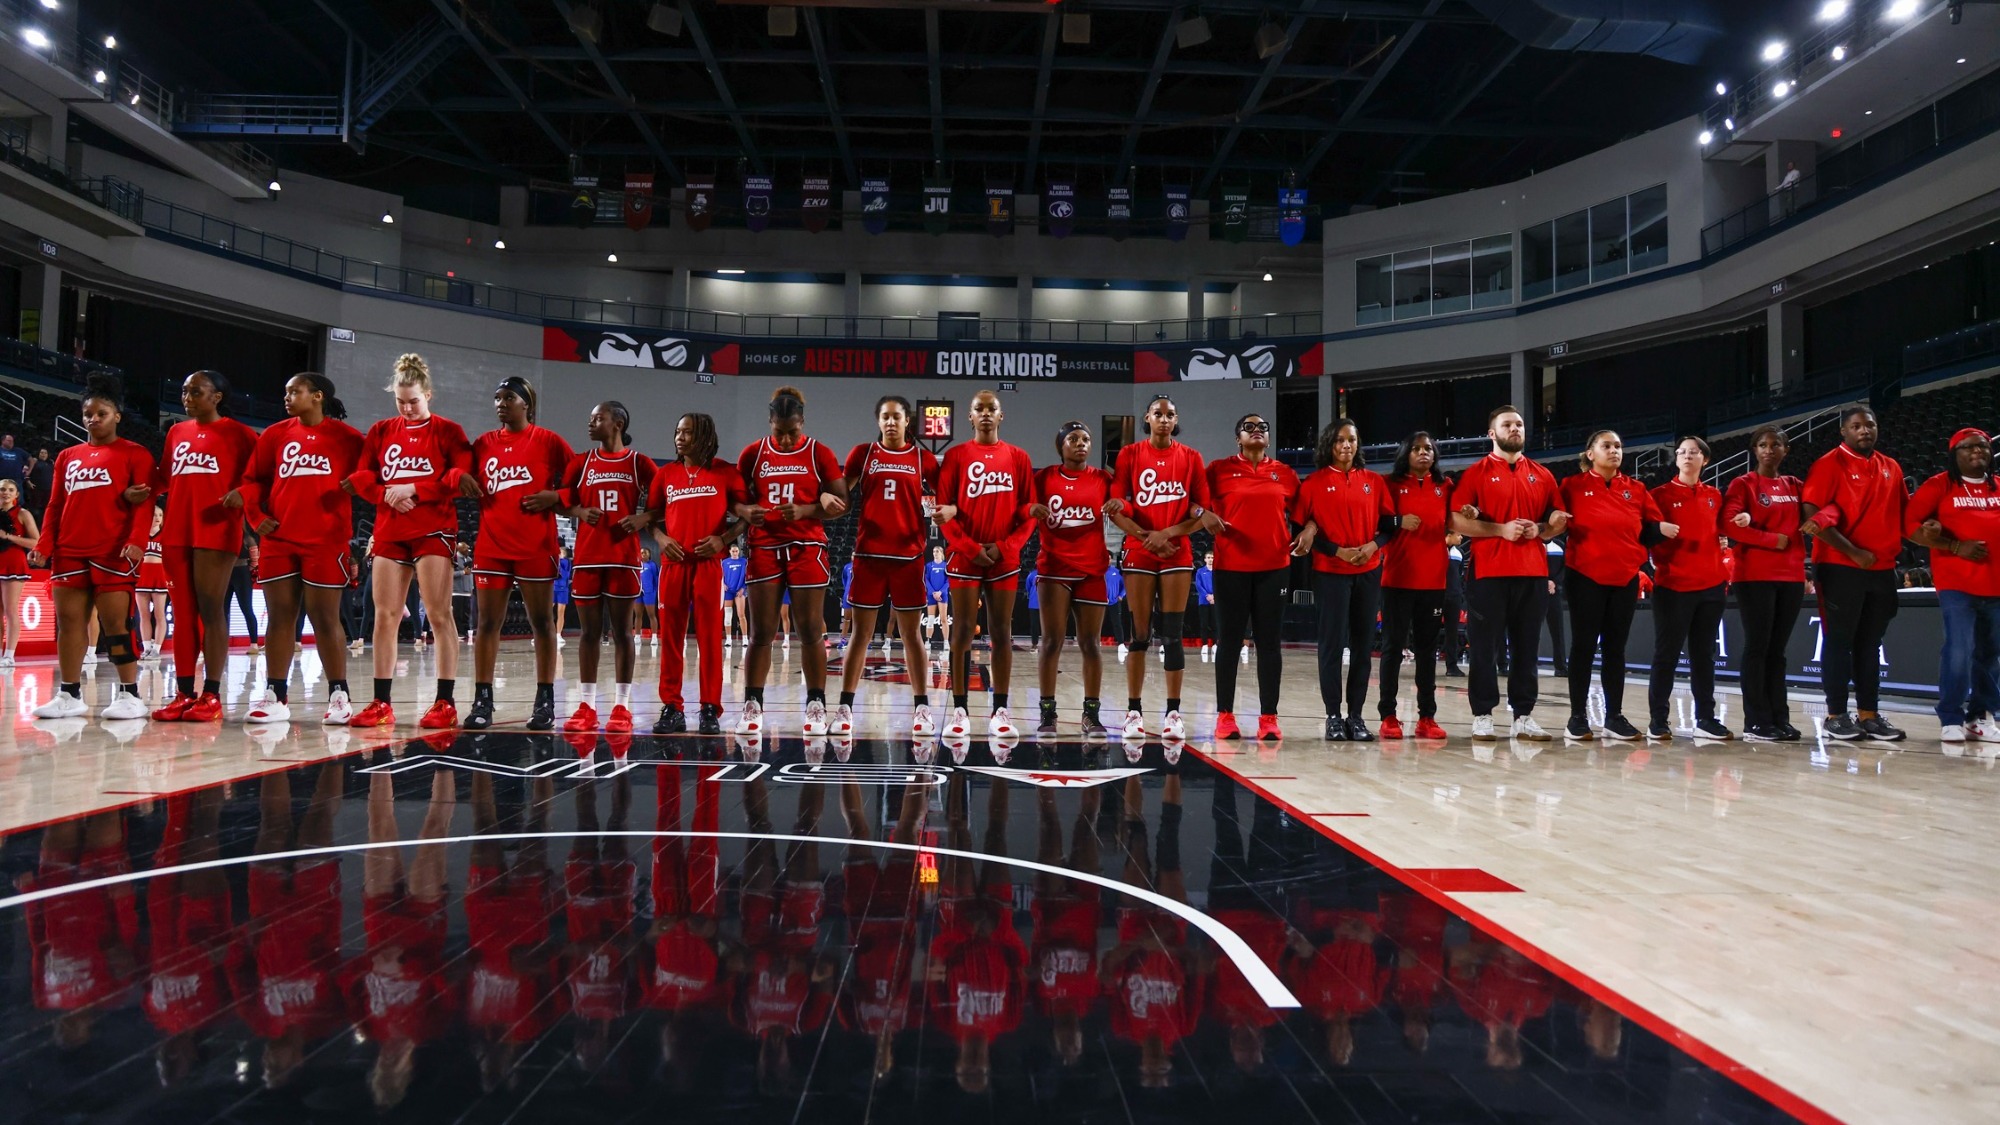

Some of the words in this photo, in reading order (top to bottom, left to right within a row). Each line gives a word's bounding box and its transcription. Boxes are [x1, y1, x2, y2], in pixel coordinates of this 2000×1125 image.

[802, 198, 829, 208] EKU
[924, 197, 949, 214] JU
[42, 242, 58, 256] 108
[1771, 283, 1784, 295] 114
[1553, 345, 1564, 355] 113
[745, 354, 779, 364] HOME
[781, 354, 798, 365] OF
[804, 347, 877, 374] AUSTIN
[881, 349, 929, 375] PEAY
[936, 351, 1059, 378] GOVERNORS
[1061, 360, 1131, 371] BASKETBALL
[699, 375, 711, 383] 110
[1002, 383, 1013, 391] 111
[1255, 381, 1268, 389] 112
[926, 406, 949, 418] 10:00
[172, 441, 220, 477] Govs
[279, 441, 332, 478] Govs
[381, 443, 434, 481] Govs
[869, 458, 918, 475] Governors
[65, 459, 112, 495] Govs
[486, 456, 533, 495] Govs
[586, 468, 634, 487] Governors
[760, 461, 809, 479] Governors
[967, 461, 1014, 498] Govs
[666, 484, 718, 505] Governors
[768, 482, 795, 505] 24
[883, 478, 897, 501] 2
[1136, 468, 1187, 507] Govs
[598, 489, 619, 512] 12
[1953, 496, 1987, 508] AUSTIN
[1988, 497, 2000, 507] PE
[1046, 494, 1096, 530] Govs
[22, 595, 42, 630] 0
